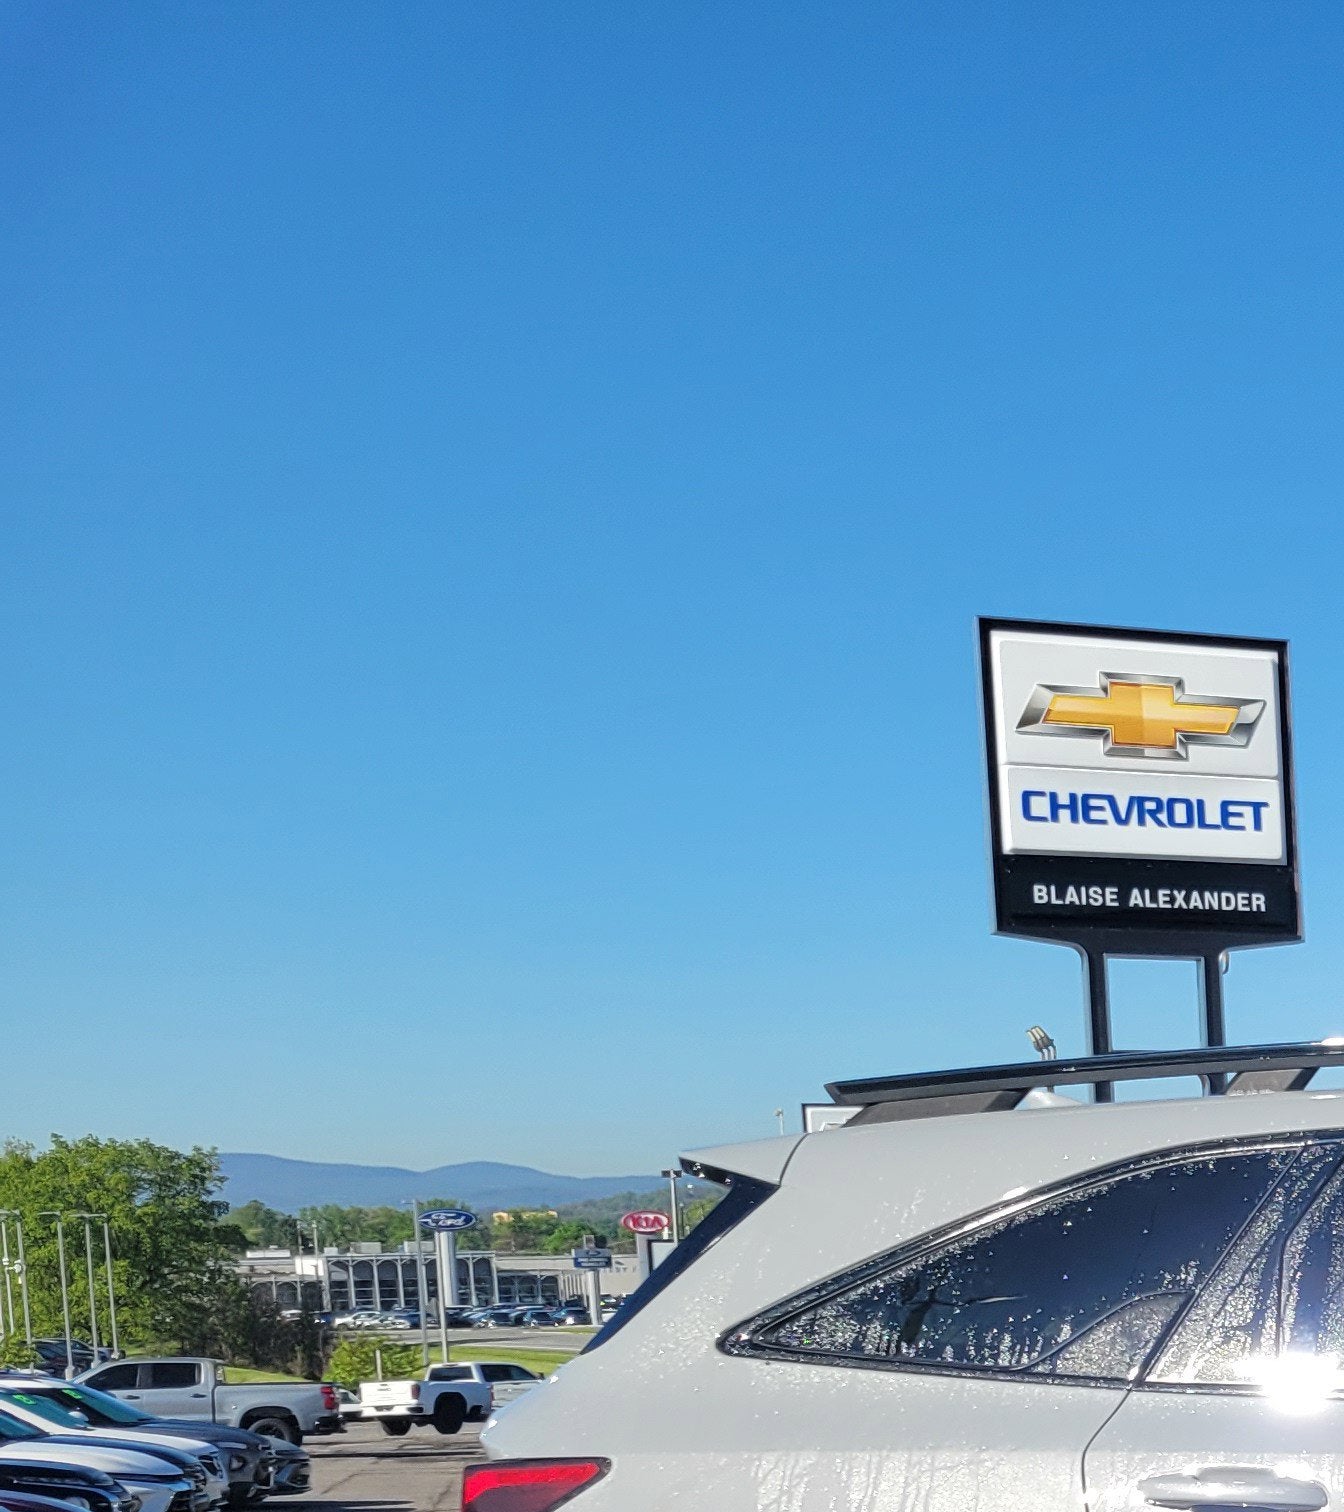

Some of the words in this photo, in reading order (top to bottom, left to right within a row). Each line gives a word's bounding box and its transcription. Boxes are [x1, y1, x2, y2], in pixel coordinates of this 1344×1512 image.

[1020, 789, 1270, 833] CHEVROLET
[1032, 884, 1121, 908] BLAISE
[1128, 887, 1267, 913] ALEXANDER
[429, 1212, 467, 1227] Ford
[630, 1214, 664, 1229] KIA
